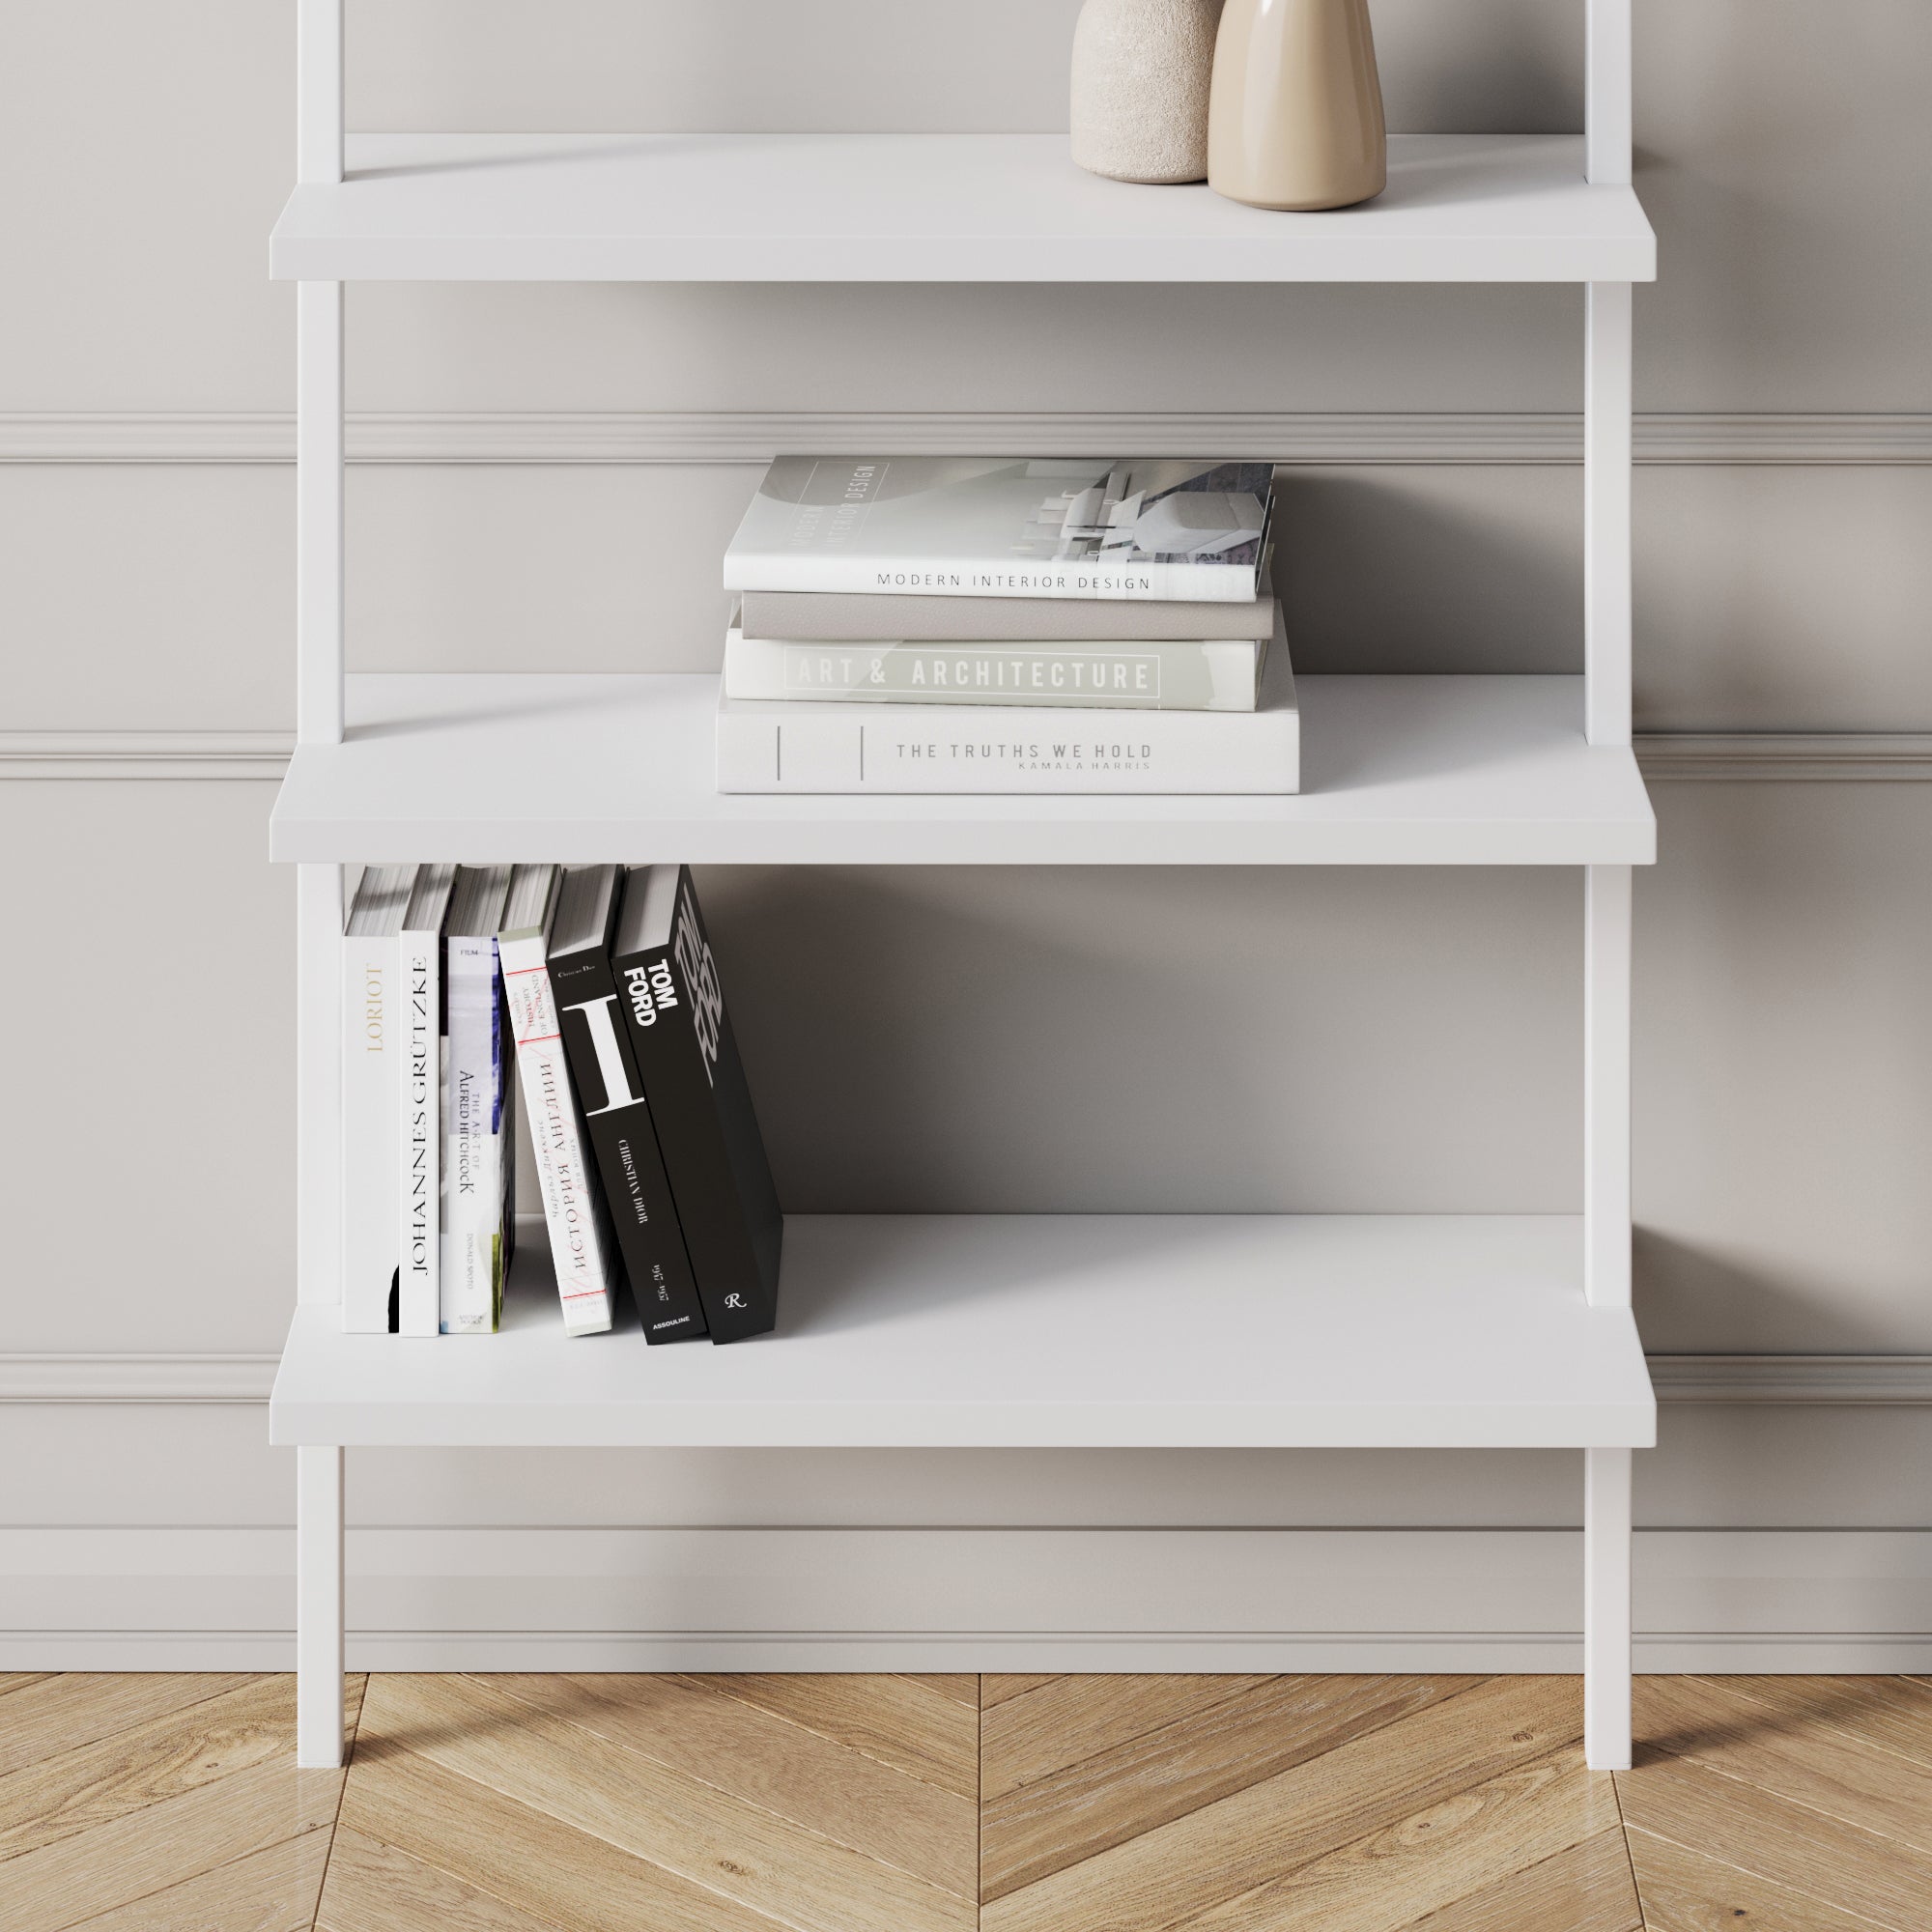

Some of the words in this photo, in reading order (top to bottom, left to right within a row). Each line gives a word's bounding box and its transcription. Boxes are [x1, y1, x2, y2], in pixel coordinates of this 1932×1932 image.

[844, 464, 876, 498] DESIGN
[877, 573, 960, 586] MODERN
[972, 575, 1066, 588] INTERIOR
[1077, 577, 1151, 590] DESIGN
[796, 658, 852, 684] ART
[869, 659, 886, 684] &
[911, 660, 1150, 689] ARCHITECTURE
[896, 745, 937, 758] THE
[951, 745, 1039, 758] TRUTHS
[1053, 745, 1082, 758] WE
[1095, 745, 1152, 758] HOLD
[1018, 761, 1083, 770] KAMALA
[1092, 761, 1151, 770] HARRIS
[366, 963, 384, 1052] LORIOT
[523, 987, 534, 1028] HISTORY
[532, 975, 546, 1020] ENGLAND
[624, 967, 657, 1027] FORD
[648, 958, 678, 1010] TOM
[411, 956, 426, 1104] GRÜTZKE
[460, 1070, 474, 1118] ALFRED
[540, 1064, 566, 1151] АНГЛИИ
[460, 1122, 474, 1194] HITCHCOCK
[618, 1139, 640, 1195] CHRISTIAN
[633, 1197, 648, 1224] DIOR
[412, 1112, 428, 1276] JOHANNES
[557, 1163, 586, 1269] ИСТОРИЯ
[653, 1316, 690, 1330] ASSOULINE
[724, 1293, 748, 1308] R
